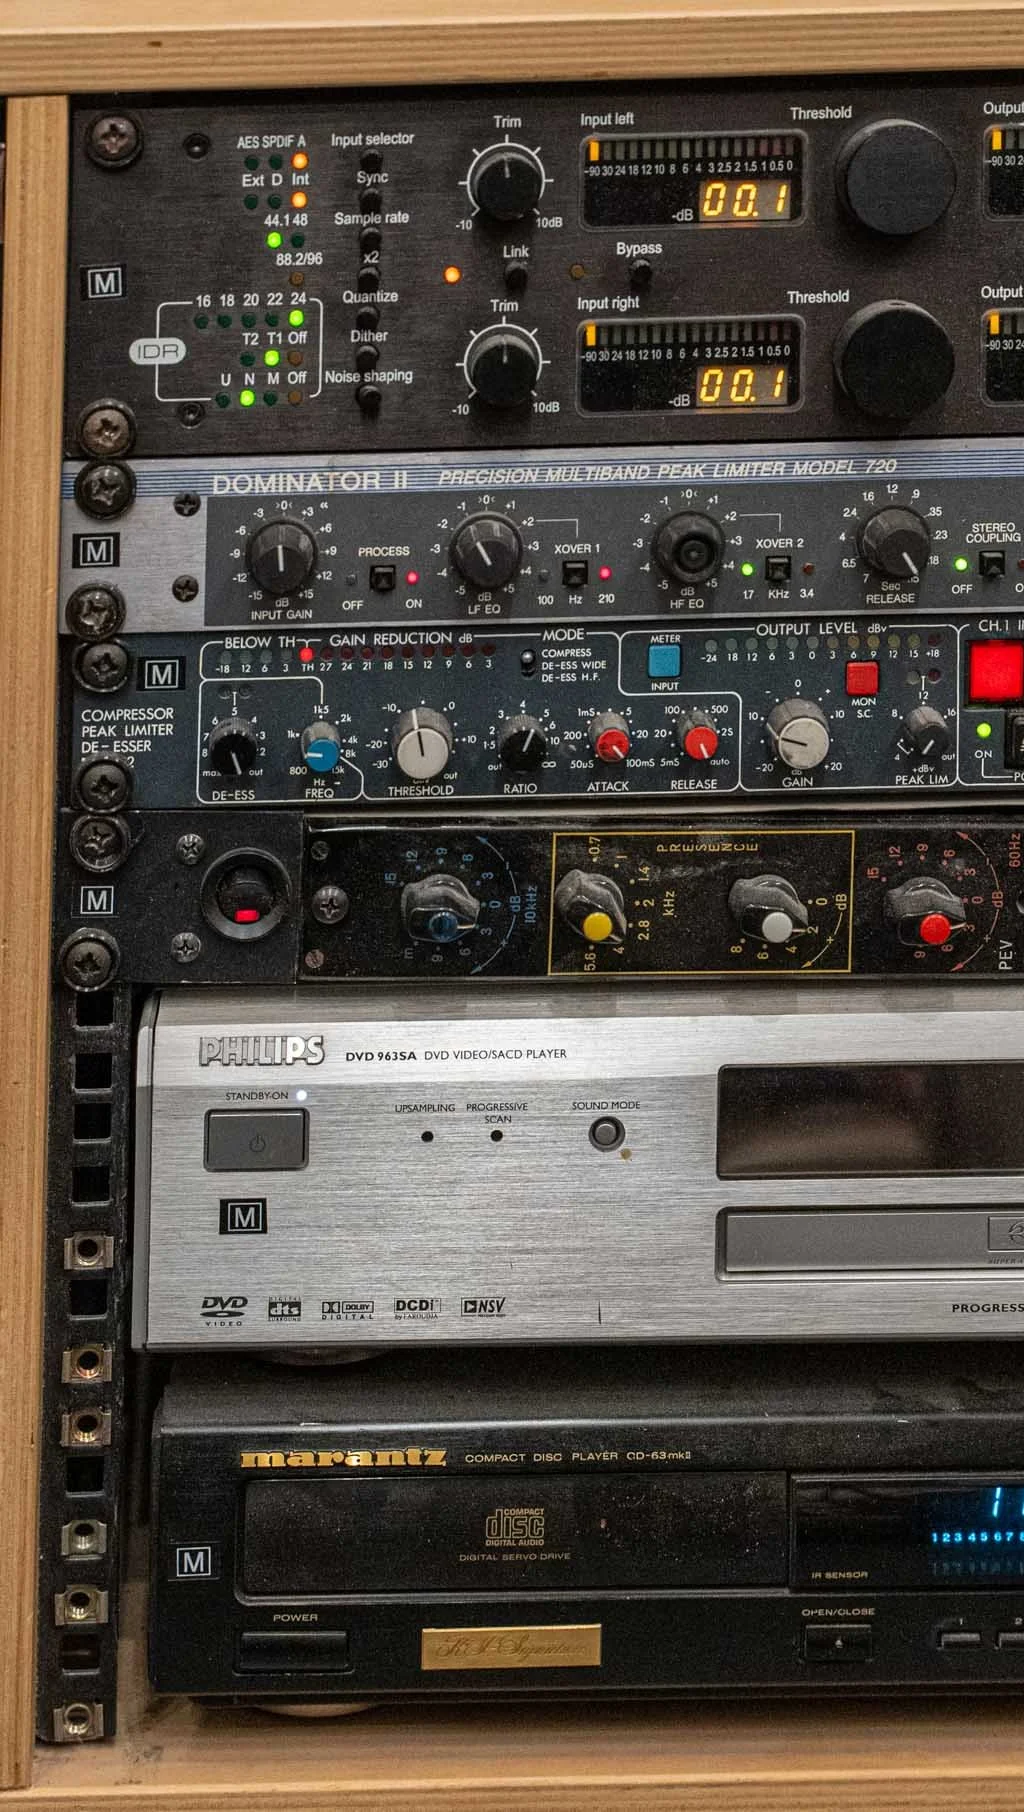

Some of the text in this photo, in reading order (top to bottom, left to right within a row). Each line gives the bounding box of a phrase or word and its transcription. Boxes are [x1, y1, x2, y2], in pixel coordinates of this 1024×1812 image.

[791, 106, 852, 120] Threshold
[983, 102, 1024, 115] Output
[494, 115, 522, 128] Trim
[581, 112, 634, 126] Input left
[237, 135, 306, 148] AES SPDIF A
[331, 132, 414, 147] Input selector
[242, 173, 309, 187] Ext D Int
[357, 171, 388, 185] Sync
[703, 183, 787, 217] 00.1
[264, 214, 308, 226] 44.1 48
[335, 212, 409, 226] Sample rate
[504, 246, 528, 258] Link
[616, 242, 662, 256] Bypass
[276, 252, 323, 266] 88.2/96
[343, 290, 398, 304] Quantize
[981, 286, 1023, 299] Output
[577, 296, 639, 311] Input right
[351, 330, 388, 342] Dither
[325, 370, 413, 384] Noise shaping
[212, 458, 897, 495] DOMINATOR II PRECISION MULTIBAND PEAK LIMITER MODEL 720
[972, 523, 1015, 533] STEREO
[966, 533, 1021, 544] COUPLING
[358, 547, 410, 557] PROCESS
[555, 544, 591, 554] XOVER
[342, 600, 363, 610] OFF
[405, 599, 422, 609] ON
[251, 609, 312, 620] INPUT GAIN
[543, 628, 584, 641] MODE
[756, 623, 810, 636] OUTPUT
[819, 622, 858, 634] LEVEL
[224, 637, 296, 648] BELOW TH
[329, 631, 472, 647] GAIN REDUCTION dB
[650, 634, 681, 643] METER
[541, 648, 591, 657] COMPRESS
[651, 682, 678, 691] INPUT
[82, 708, 174, 722] COMPRESSOR
[82, 724, 173, 737] PEAK LIMITER
[671, 779, 717, 790] RELEASE
[782, 776, 813, 787] GAIN
[896, 774, 948, 785] PEAK LIM
[389, 785, 454, 796] THRESHOLD
[503, 783, 537, 794] RATIO
[587, 781, 629, 791] ATTACK
[657, 841, 760, 853] PRESENCE
[999, 939, 1013, 970] PEV
[199, 1034, 326, 1067] PHILIPS
[346, 1052, 375, 1061] DVD
[424, 1050, 449, 1060] DVD
[452, 1049, 523, 1061] VIDEO/SACD
[526, 1048, 567, 1059] PLAYER
[395, 1103, 455, 1113] UPSAMPLING
[466, 1102, 528, 1112] PROGRESSIVE
[572, 1101, 641, 1110] SOUND MODE
[484, 1115, 511, 1124] SCAN
[202, 1296, 248, 1309] DVD
[240, 1448, 447, 1468] marantz
[465, 1451, 618, 1462] COMPACT DISC PLAYER
[801, 1607, 875, 1616] OPEN/CLOSE
[273, 1614, 318, 1622] POWER
